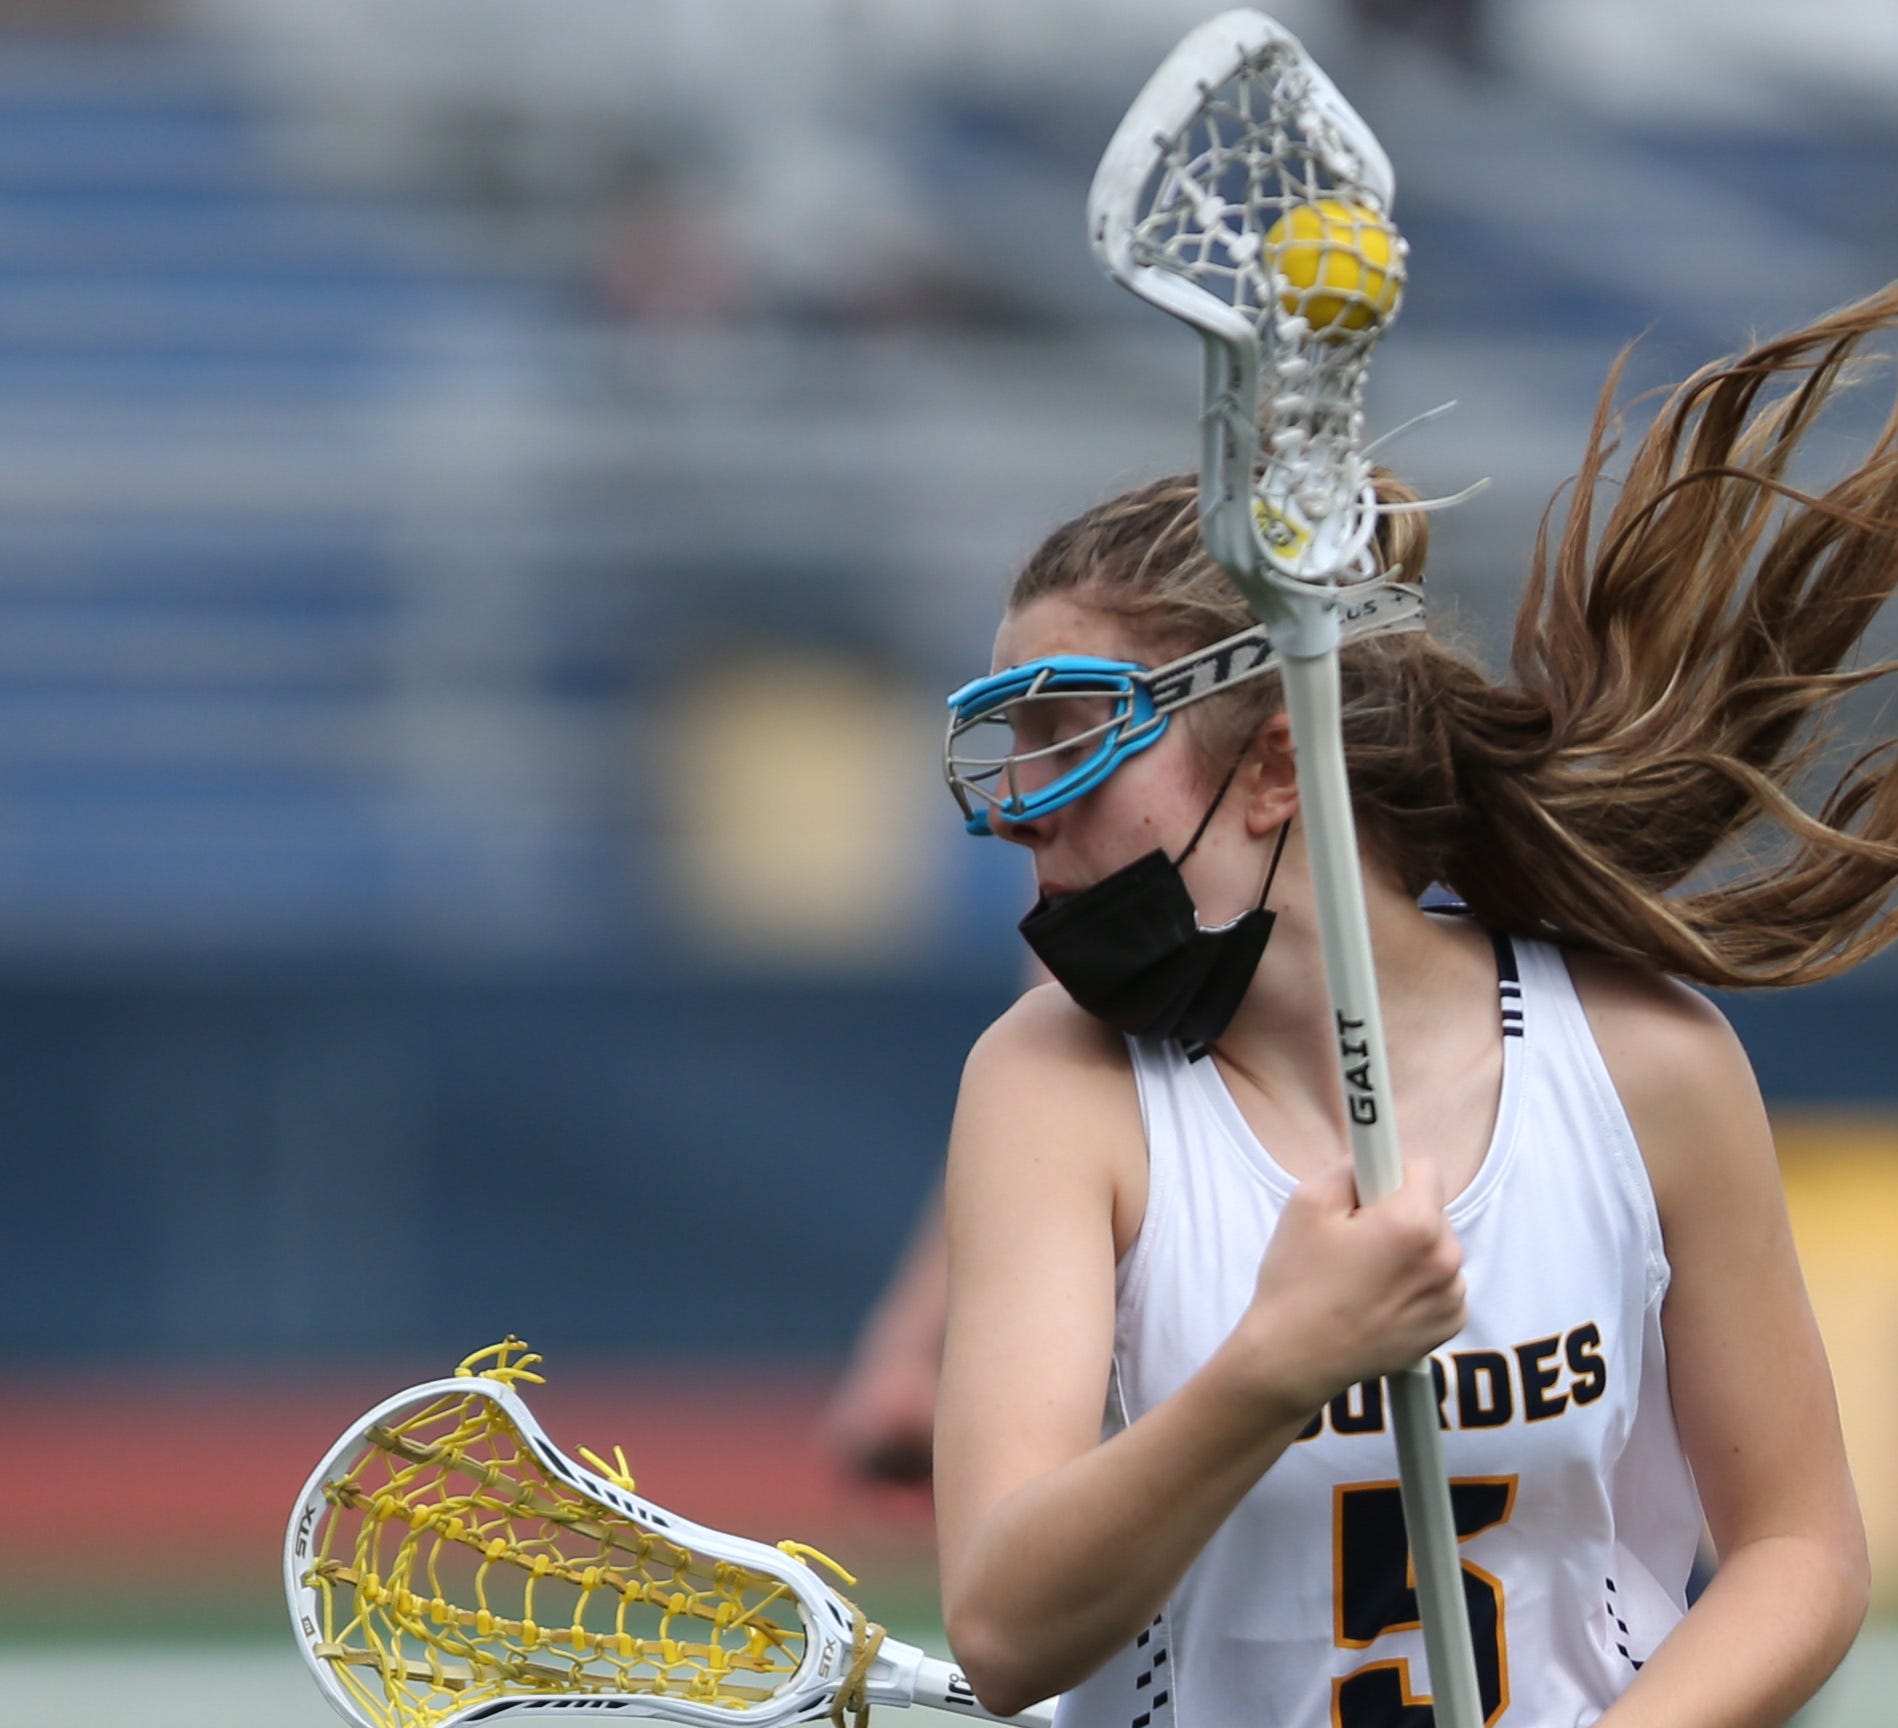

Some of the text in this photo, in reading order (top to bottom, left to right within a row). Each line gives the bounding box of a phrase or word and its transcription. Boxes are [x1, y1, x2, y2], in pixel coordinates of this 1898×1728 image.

[1336, 1008, 1378, 1126] GAIT
[295, 1504, 316, 1559] STX
[817, 1636, 837, 1680] STX
